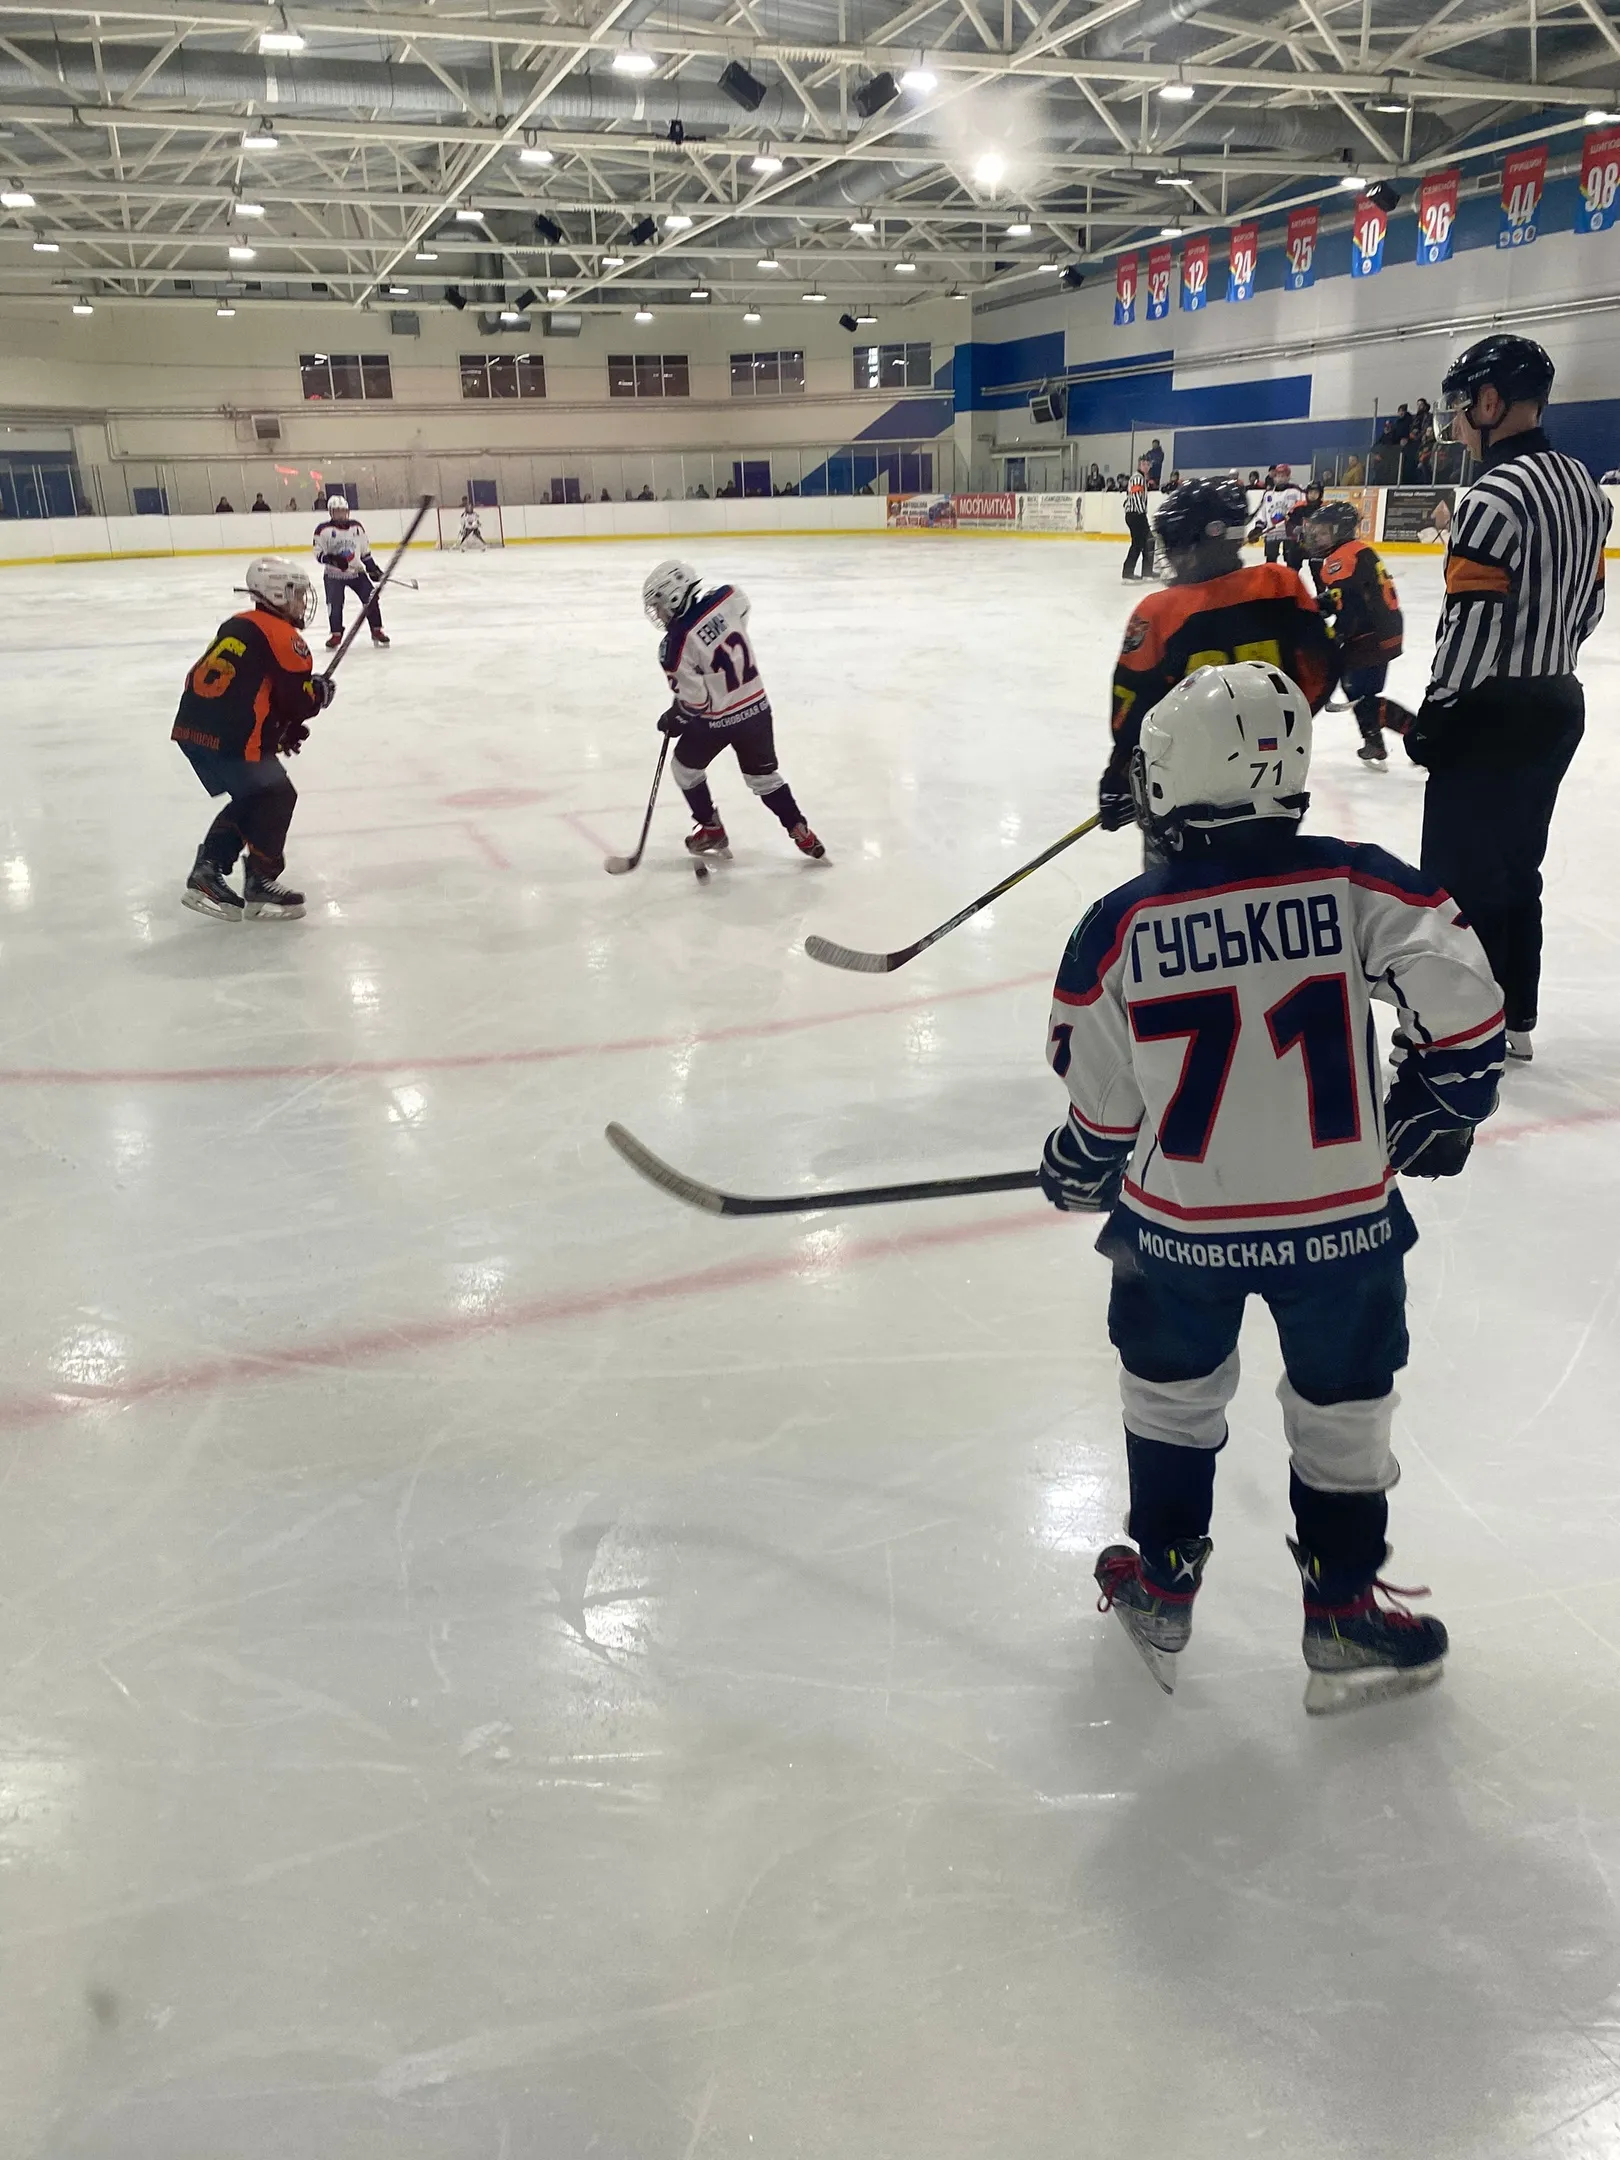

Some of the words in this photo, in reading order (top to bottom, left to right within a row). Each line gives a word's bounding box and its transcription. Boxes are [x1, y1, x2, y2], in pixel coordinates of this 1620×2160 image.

[1507, 181, 1536, 227] 44
[1585, 162, 1619, 212] 98
[1360, 218, 1380, 258] 10
[1423, 202, 1451, 246] 26
[1234, 249, 1252, 286] 24
[1291, 235, 1312, 274] 25
[1122, 279, 1132, 310] 9
[1152, 270, 1170, 304] 23
[1188, 260, 1204, 294] 12
[960, 498, 1013, 515] МОСПЛИТКА
[184, 635, 247, 698] 6
[710, 630, 759, 693] 12
[1250, 760, 1283, 789] 71
[1131, 893, 1343, 983] ГУСЬКОВ
[1127, 971, 1361, 1164] 71
[1138, 1227, 1297, 1268] МОСКОВСКАЯ
